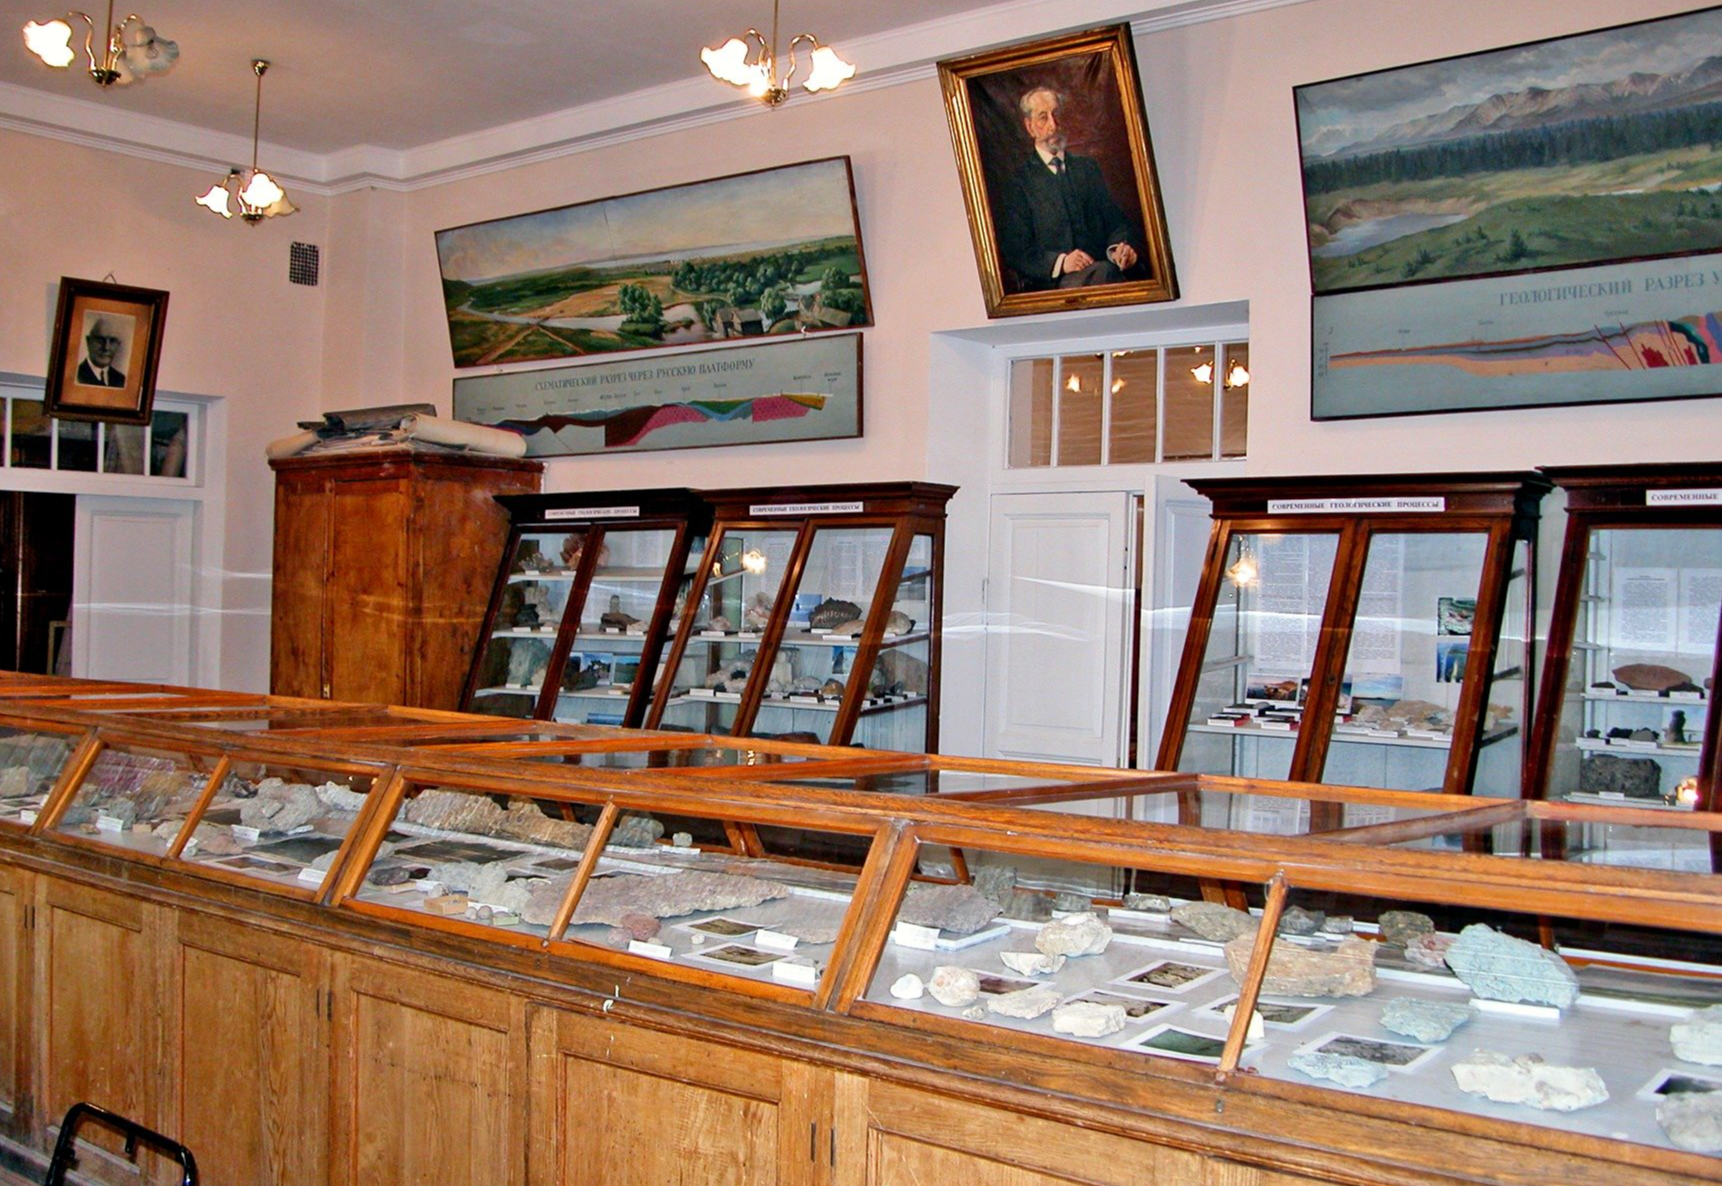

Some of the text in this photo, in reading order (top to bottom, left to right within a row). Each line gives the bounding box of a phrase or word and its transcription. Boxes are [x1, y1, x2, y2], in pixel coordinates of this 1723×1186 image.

[1500, 278, 1632, 306] ГЕОЛОГИЧЕСКИЙ
[1645, 271, 1704, 292] РАЗРЕЗ
[535, 375, 597, 391] СХЕМАТИЧЕСКИЙ
[656, 366, 696, 379] РУССКУЮ
[1272, 501, 1325, 510] СОВРЕМЕННЫЕ
[1329, 501, 1391, 509] ГЕОЛОГИЧЕСКИЕ
